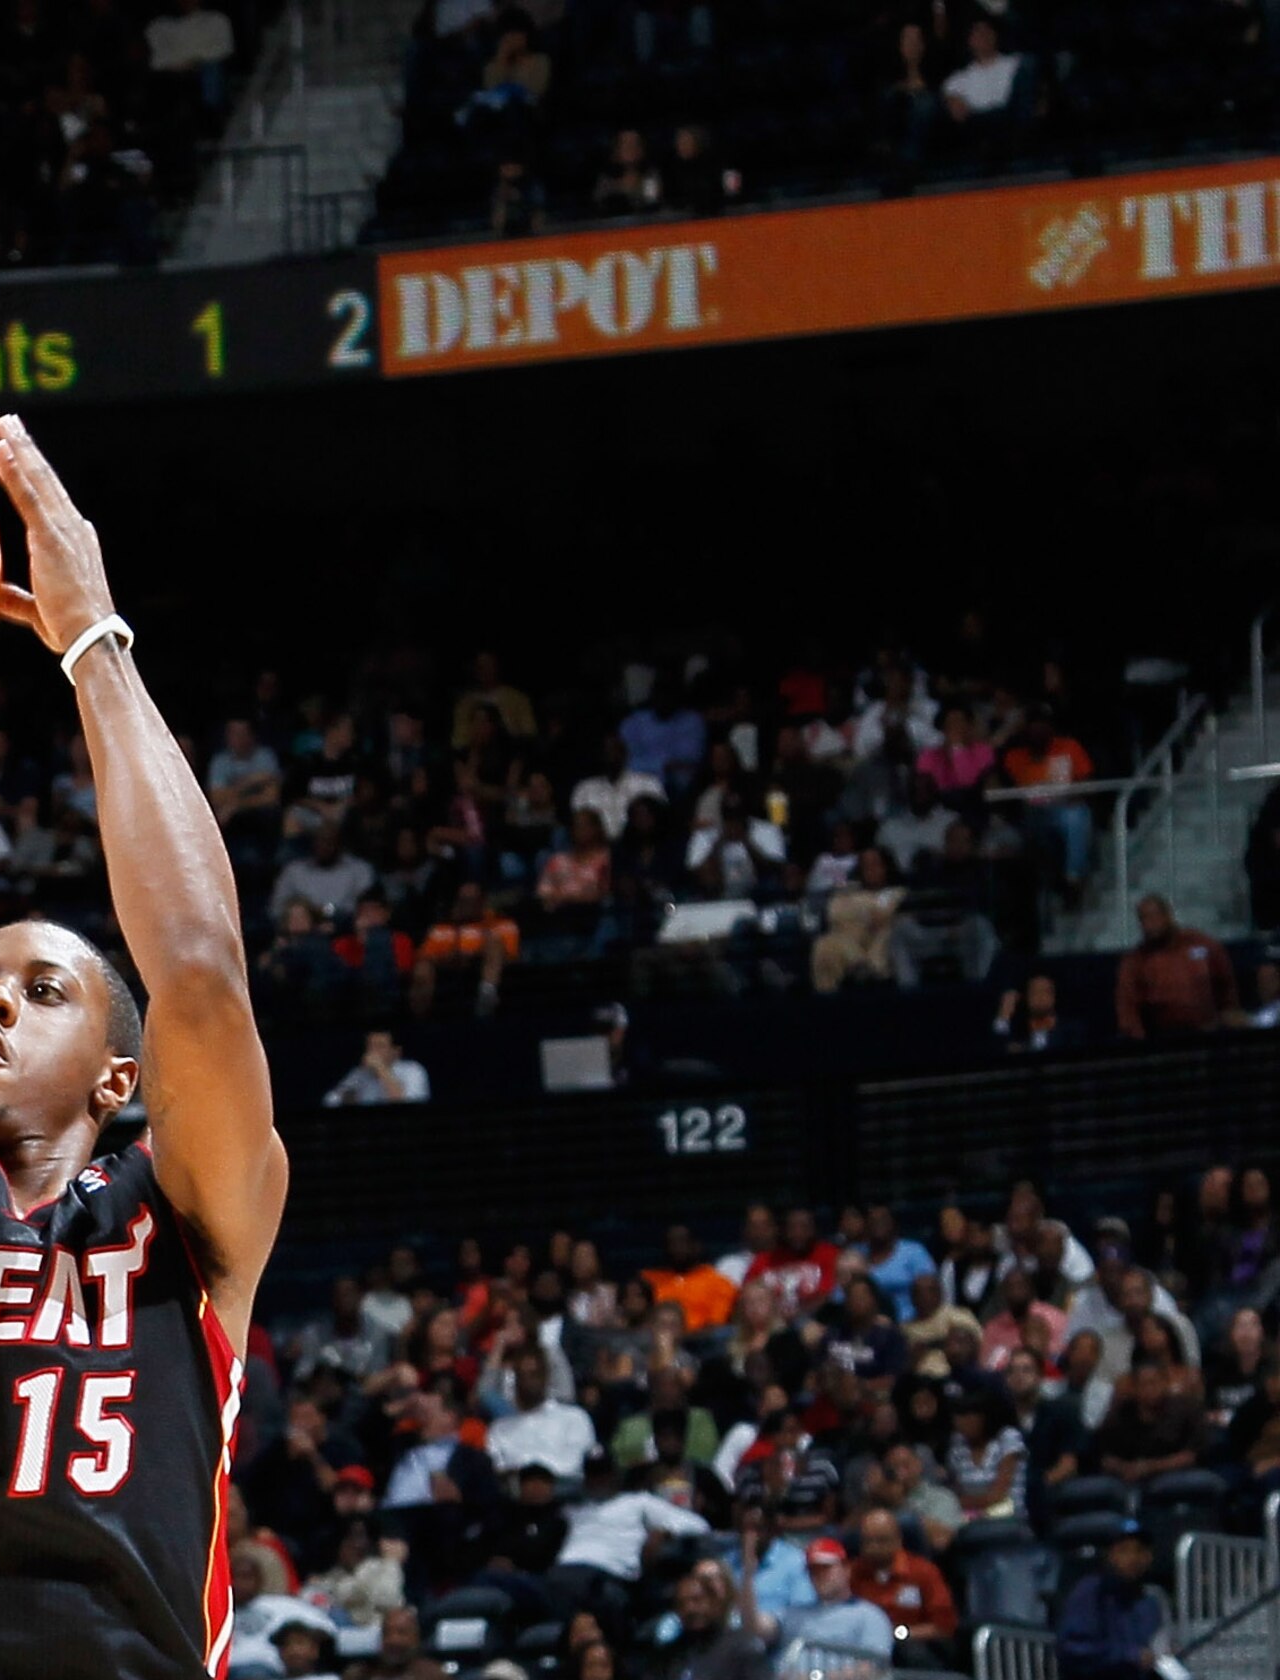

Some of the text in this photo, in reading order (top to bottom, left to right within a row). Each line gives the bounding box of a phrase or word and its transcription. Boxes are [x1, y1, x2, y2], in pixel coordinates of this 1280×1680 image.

[1120, 180, 1280, 280] TH
[190, 301, 226, 377] 1
[327, 289, 372, 369] 2
[395, 241, 718, 358] DEPOT
[658, 1104, 746, 1153] 122
[6, 1365, 136, 1499] 15
